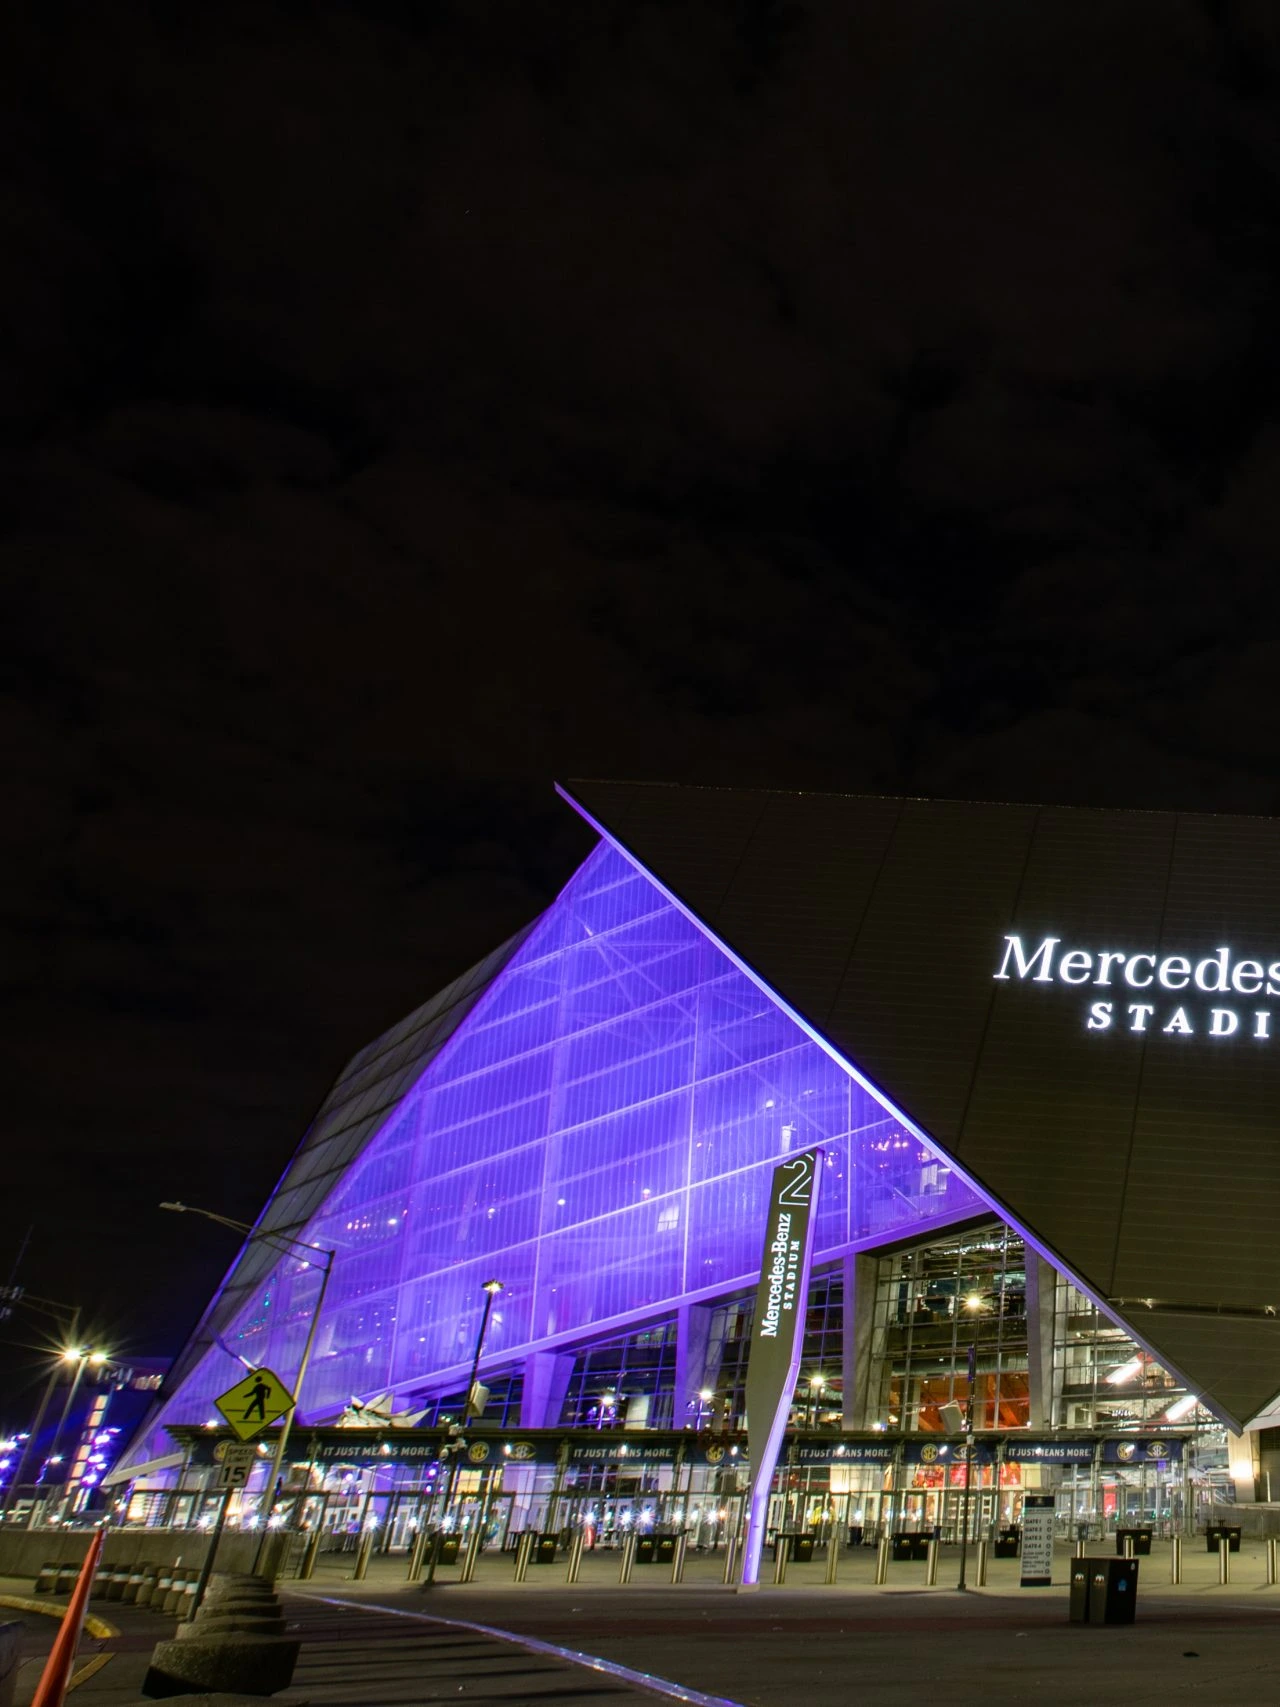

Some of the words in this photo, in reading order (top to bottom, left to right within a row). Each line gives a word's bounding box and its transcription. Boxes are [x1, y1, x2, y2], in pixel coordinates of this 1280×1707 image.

[760, 1212, 791, 1337] Mercedes-Benz
[783, 1240, 800, 1310] STADIUM
[229, 1448, 253, 1456] SPEED
[323, 1446, 335, 1457] IT
[334, 1446, 361, 1457] JUST
[361, 1446, 399, 1457] MEAS
[573, 1448, 584, 1458] IT
[583, 1448, 606, 1458] JUST
[800, 1449, 809, 1459] IT
[809, 1449, 831, 1459] JUST
[1008, 1448, 1016, 1457] IT
[1016, 1448, 1036, 1457] JUST
[1036, 1448, 1065, 1457] MEANS
[223, 1466, 247, 1483] 15
